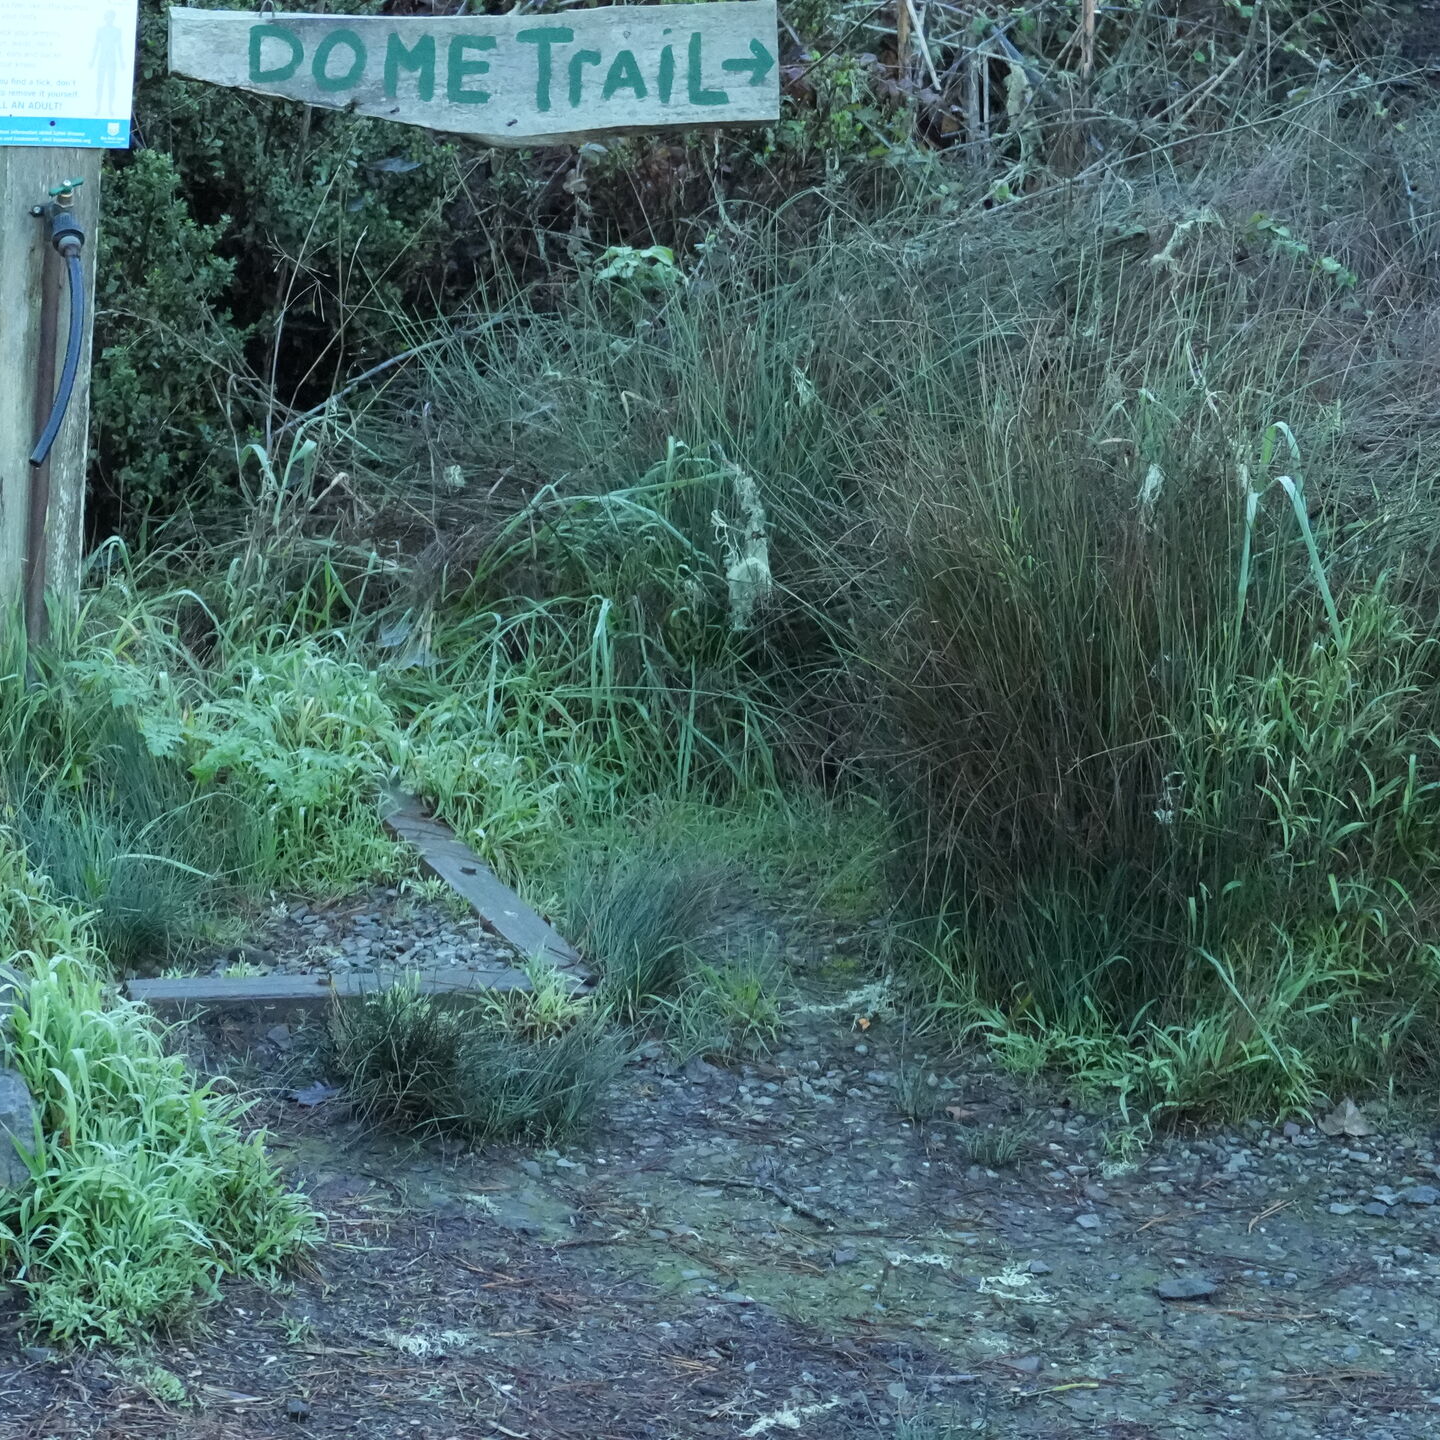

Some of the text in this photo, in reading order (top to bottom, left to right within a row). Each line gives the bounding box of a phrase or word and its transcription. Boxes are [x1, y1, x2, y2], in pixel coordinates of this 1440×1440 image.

[248, 23, 498, 104] DOME
[11, 77, 27, 86] find
[39, 89, 45, 97] it
[11, 101, 25, 109] AN
[28, 101, 63, 111] ADULT!
